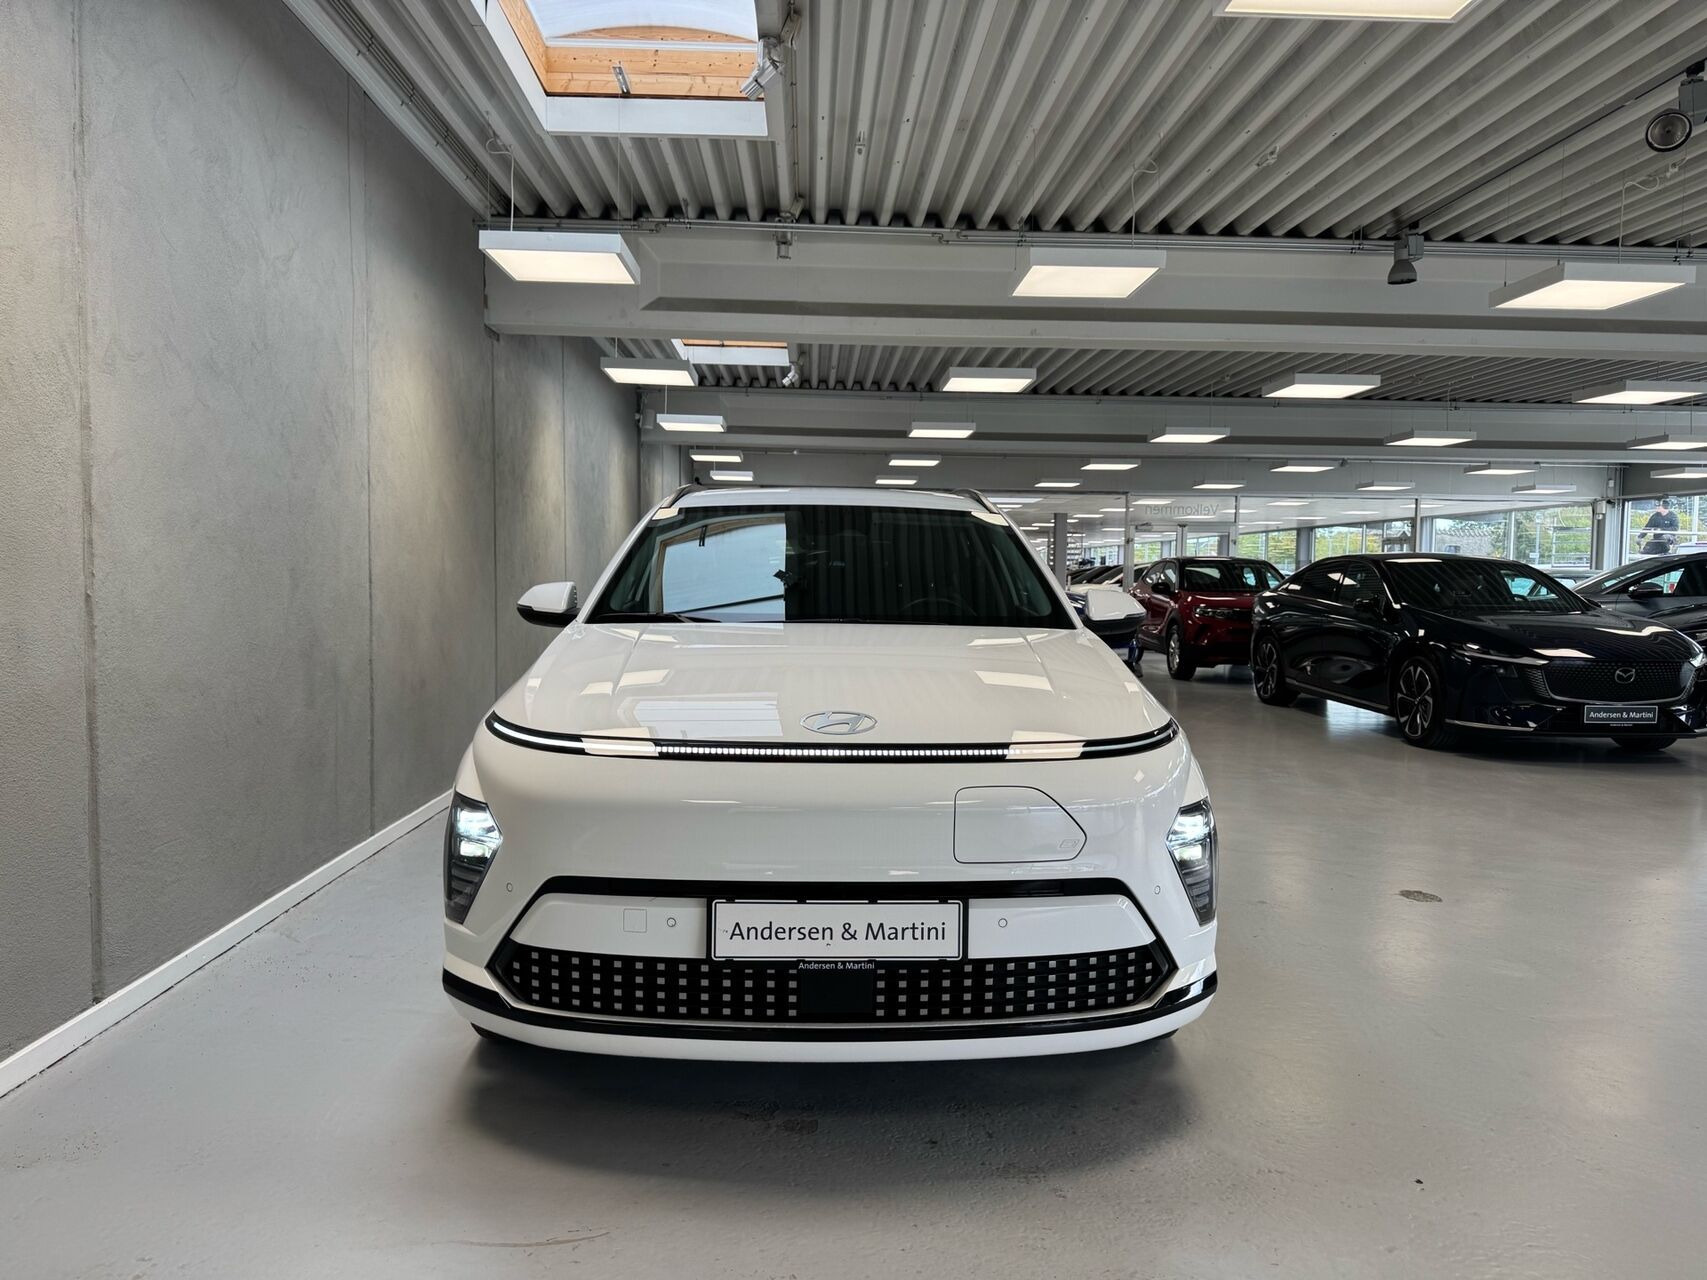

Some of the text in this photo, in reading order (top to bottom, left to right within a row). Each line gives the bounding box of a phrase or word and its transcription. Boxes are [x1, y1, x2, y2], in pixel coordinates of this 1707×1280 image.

[1589, 711, 1654, 719] Andersen & Martini
[729, 921, 946, 941] Andersen & Martini
[798, 962, 875, 970] Andersen & Martini
